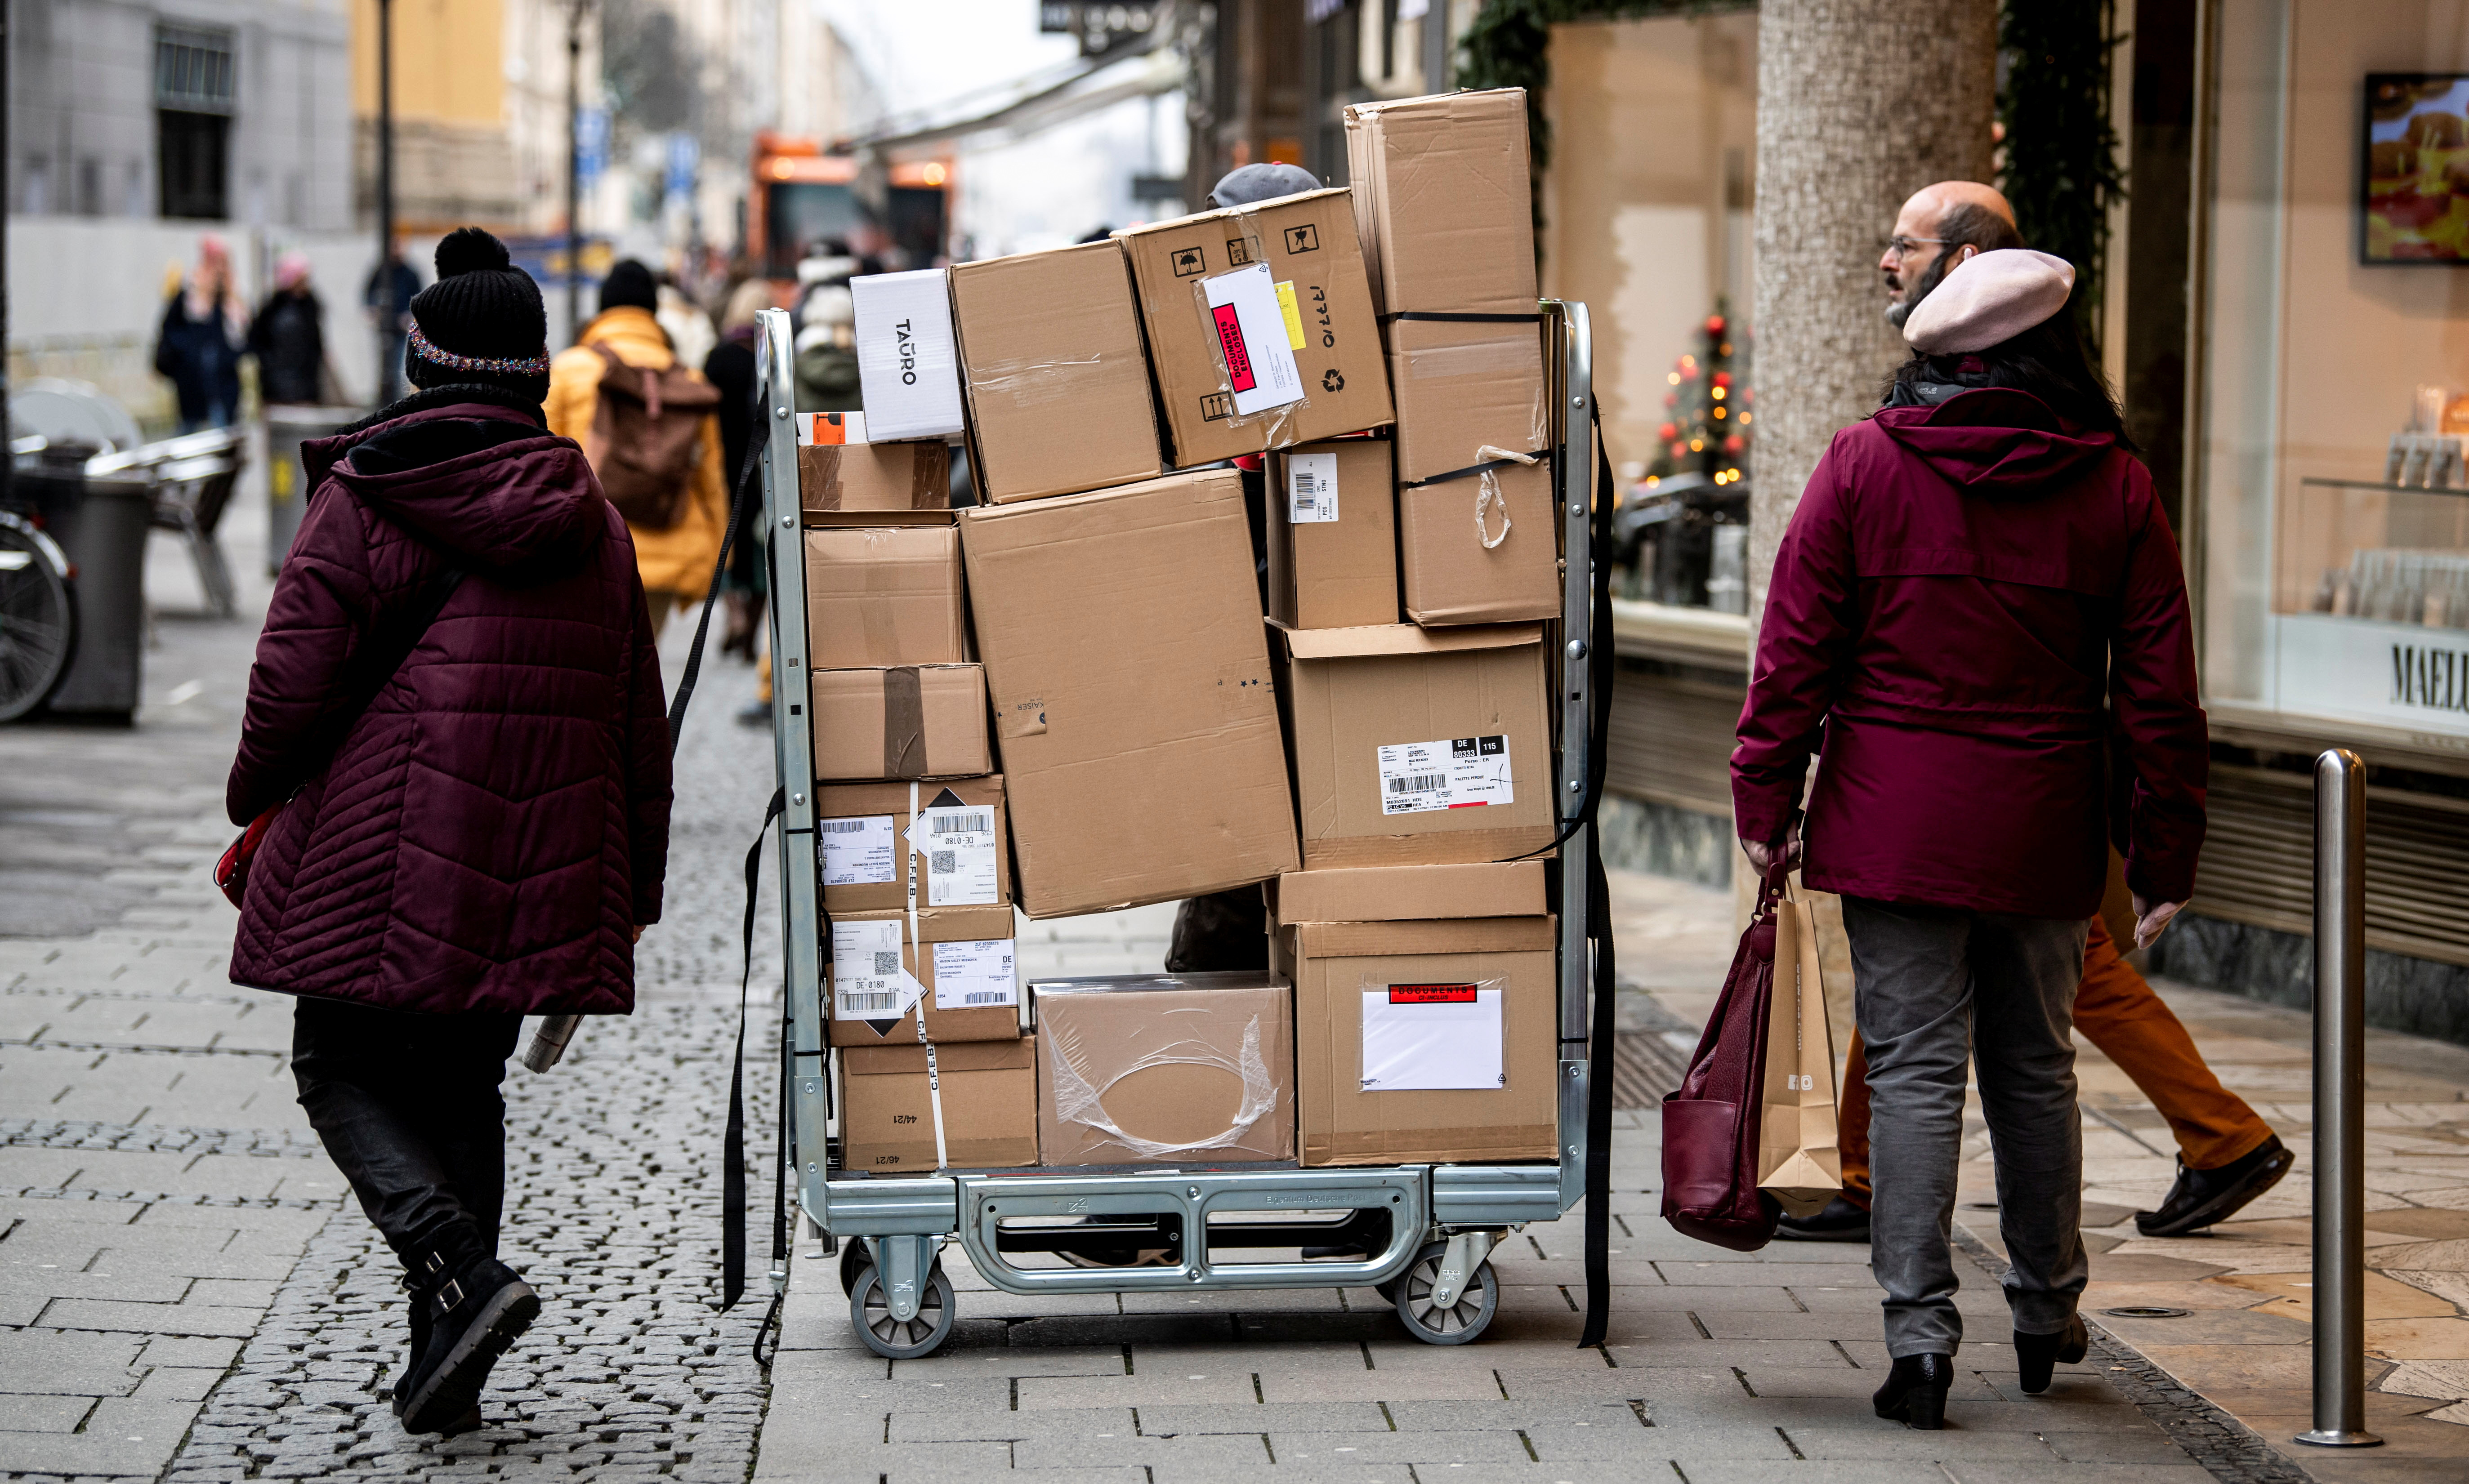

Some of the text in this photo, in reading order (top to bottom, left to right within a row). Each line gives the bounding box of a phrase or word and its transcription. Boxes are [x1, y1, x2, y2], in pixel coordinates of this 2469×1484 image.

[1221, 321, 1241, 378] DOCUMENTS
[1229, 324, 1248, 372] ENCLOSED
[1453, 749, 1475, 758] 80333
[928, 1044, 938, 1090] C.F.E.B.
[894, 1115, 917, 1124] 44/21
[876, 1156, 899, 1164] 46/21
[1266, 1196, 1304, 1204] Eigentum
